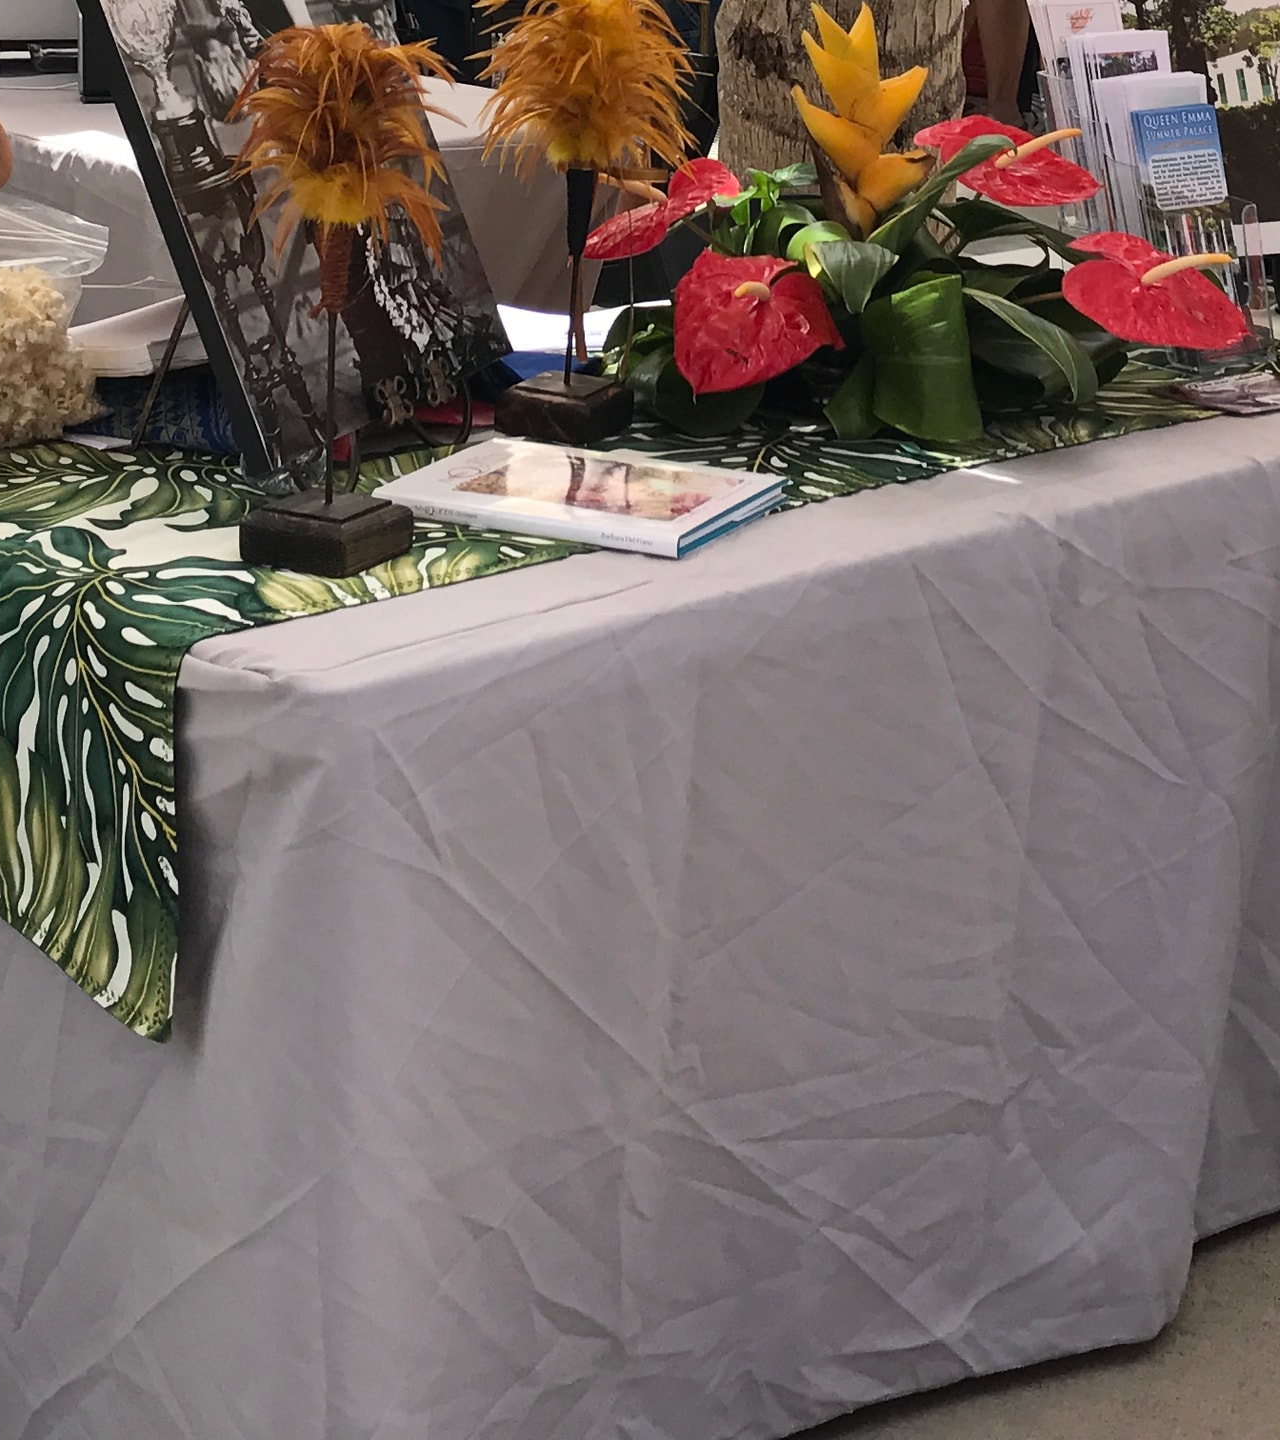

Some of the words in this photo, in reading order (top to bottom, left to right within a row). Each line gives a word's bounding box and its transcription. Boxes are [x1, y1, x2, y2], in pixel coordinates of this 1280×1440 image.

[1143, 114, 1179, 129] QUEEN
[1181, 111, 1212, 124] EMMA
[1184, 125, 1213, 136] PALACE
